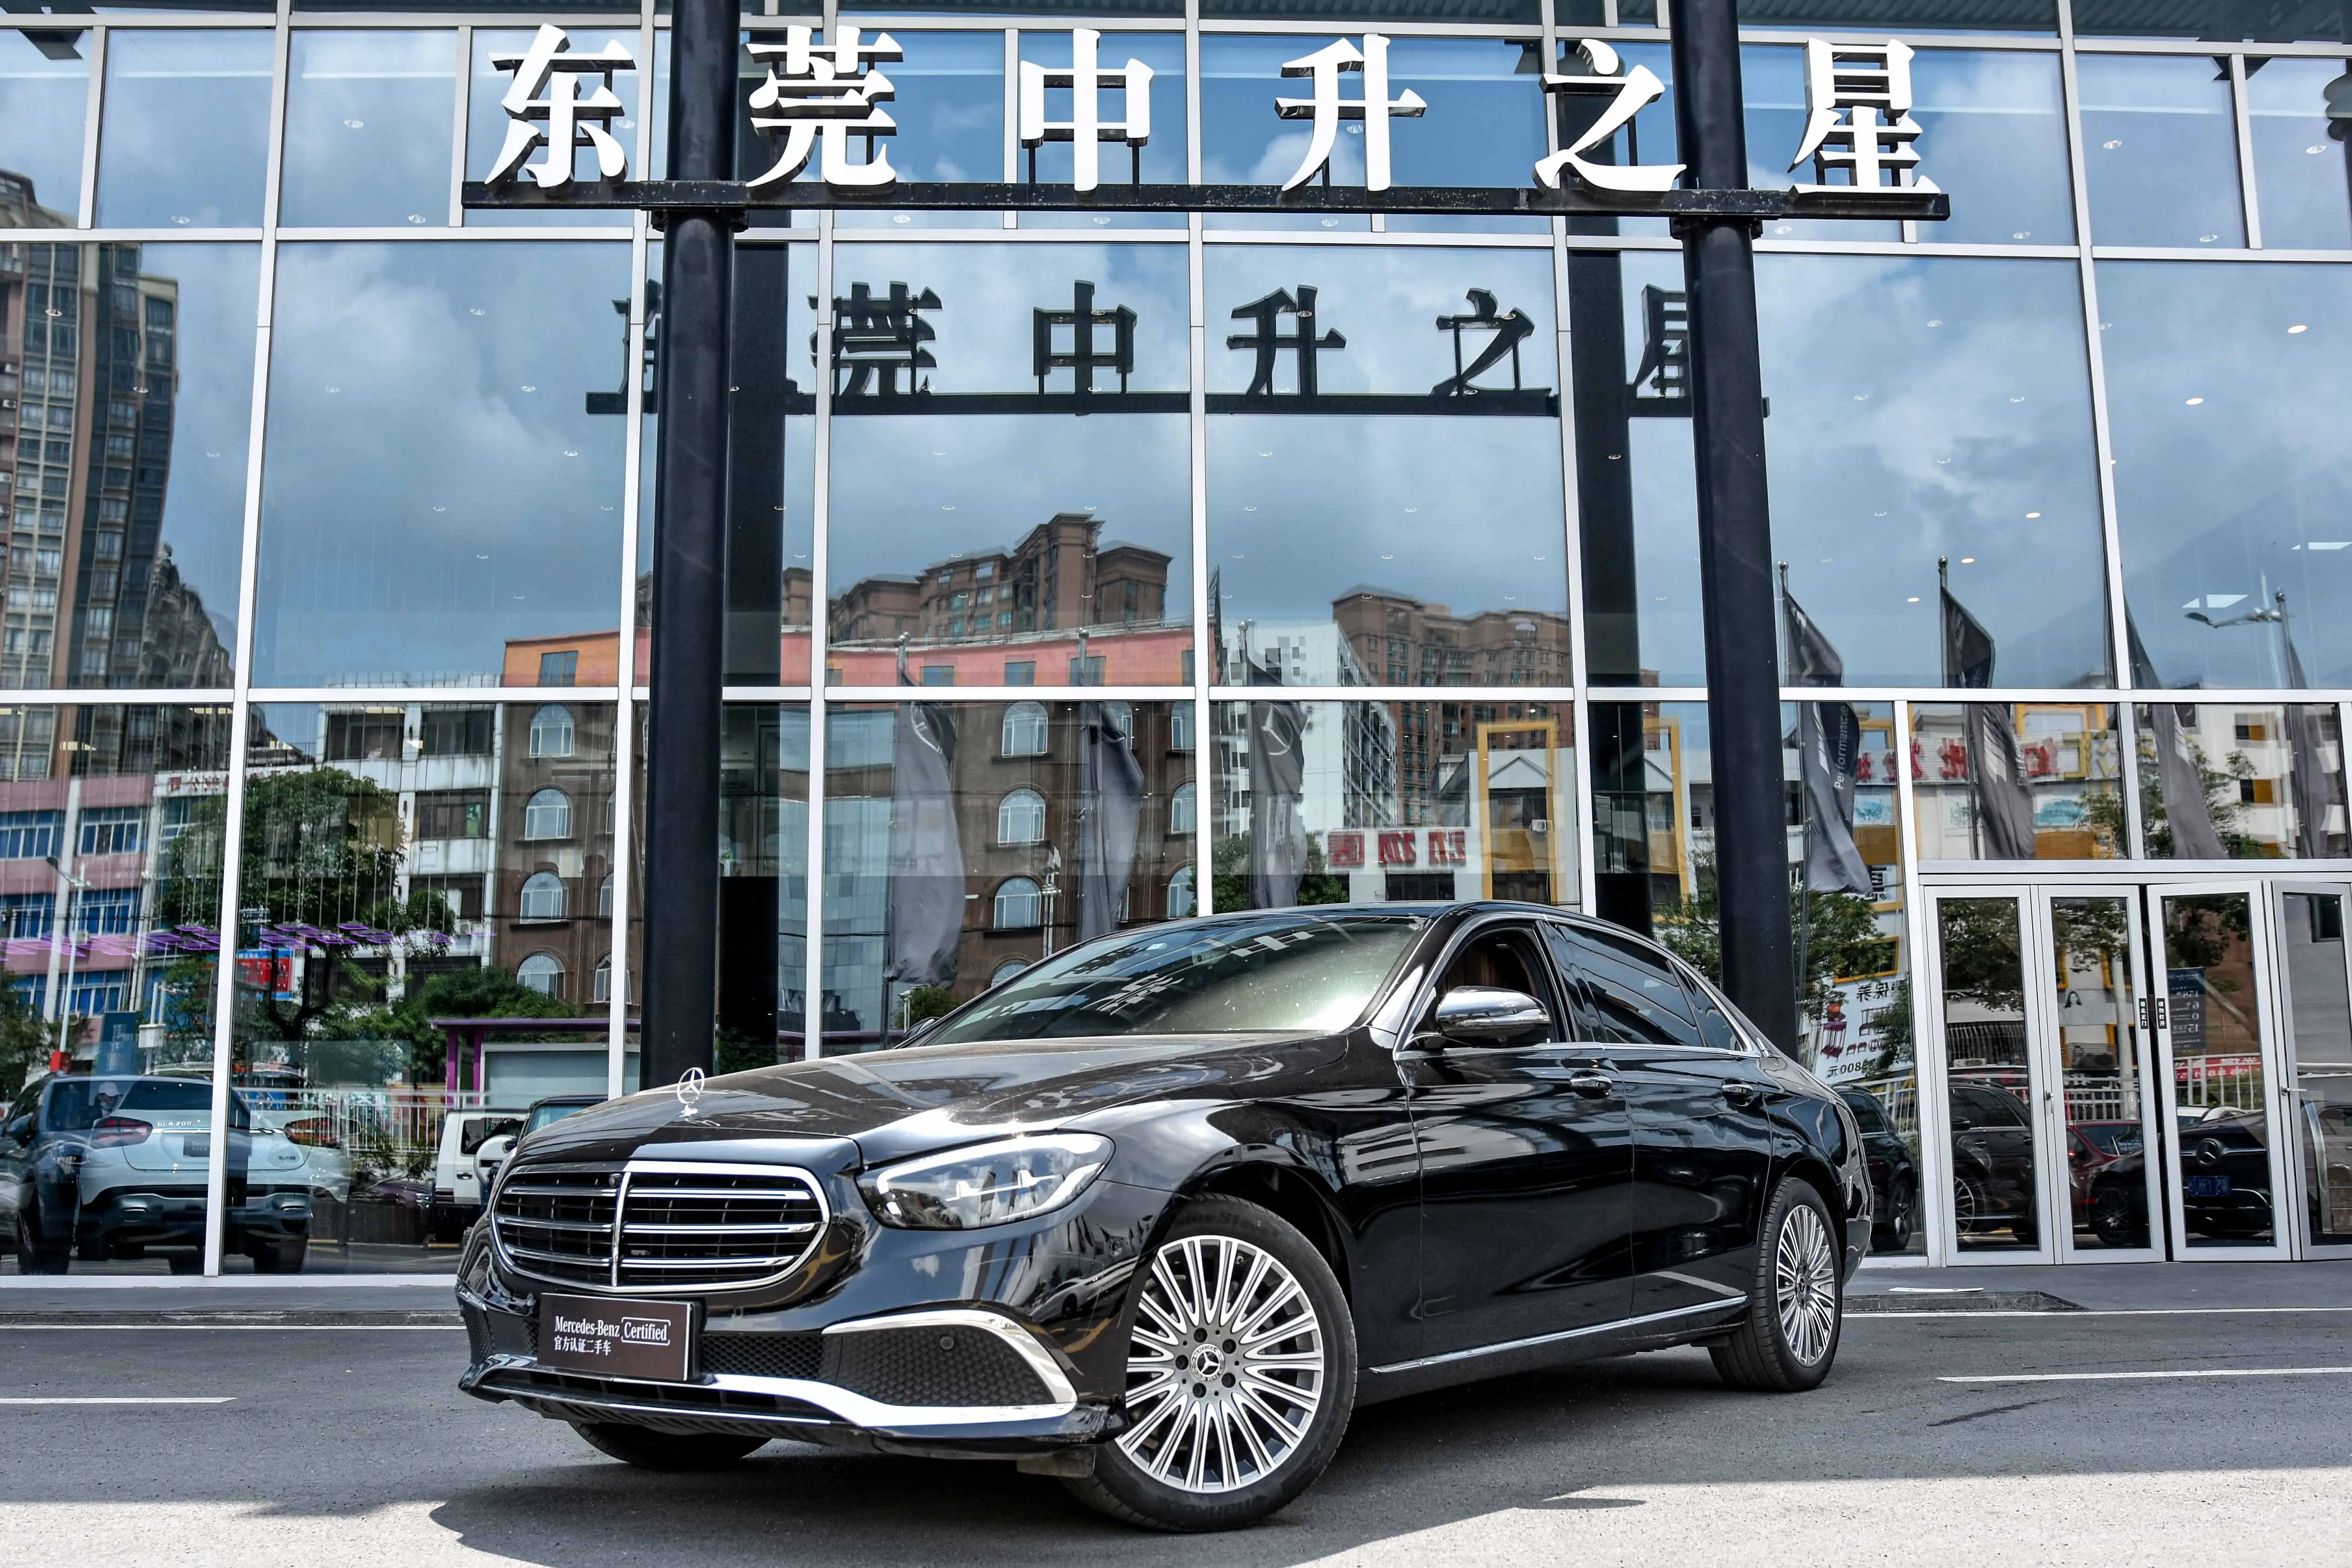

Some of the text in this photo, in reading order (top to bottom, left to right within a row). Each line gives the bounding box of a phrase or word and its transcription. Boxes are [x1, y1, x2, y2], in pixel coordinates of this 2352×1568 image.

[484, 23, 1941, 195] 东莞中升之星
[1834, 705, 1848, 790] Performance
[554, 1336, 611, 1356] 官方认证二手车
[555, 1316, 668, 1341] Mercedes-Benz Certified
